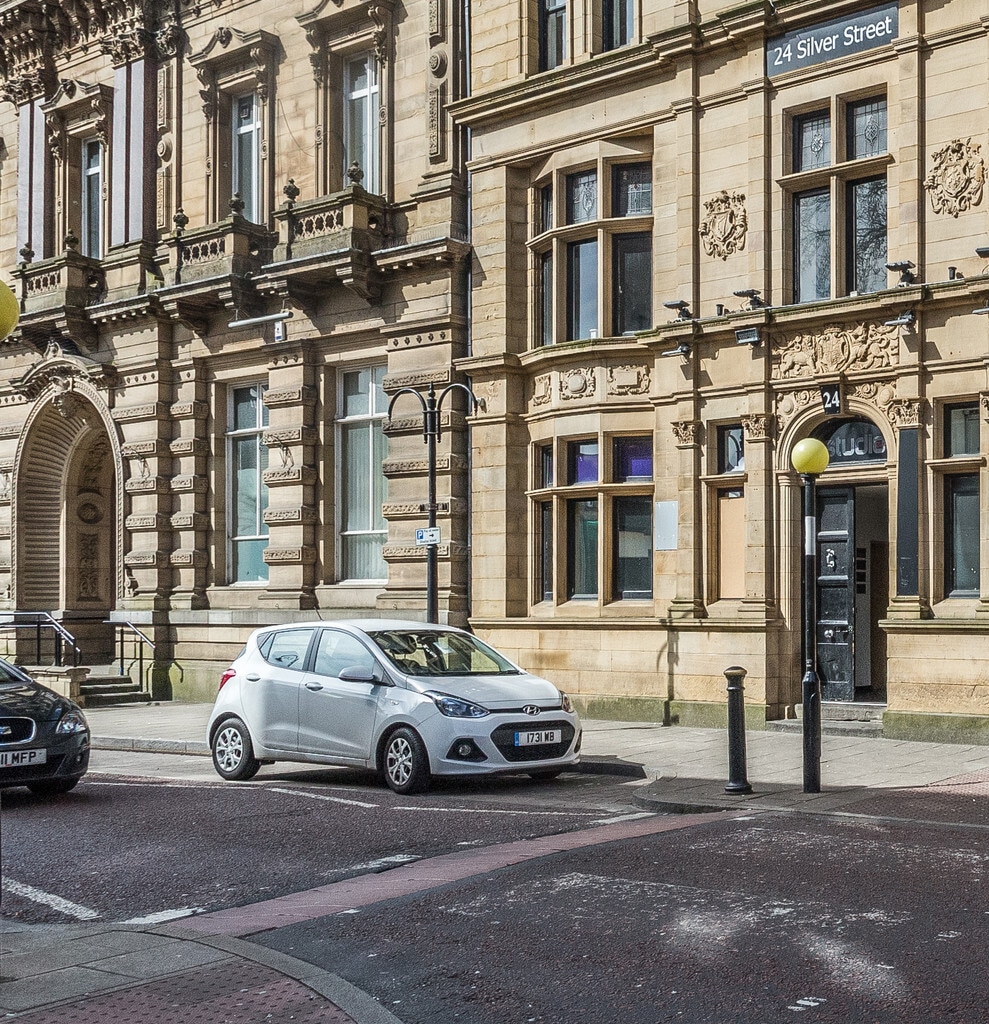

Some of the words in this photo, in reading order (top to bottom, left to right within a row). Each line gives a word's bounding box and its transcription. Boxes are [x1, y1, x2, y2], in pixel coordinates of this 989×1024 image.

[774, 44, 792, 66] 24
[797, 34, 839, 59] Silver
[843, 16, 892, 46] Street
[823, 391, 839, 408] 24
[11, 751, 36, 764] MFP
